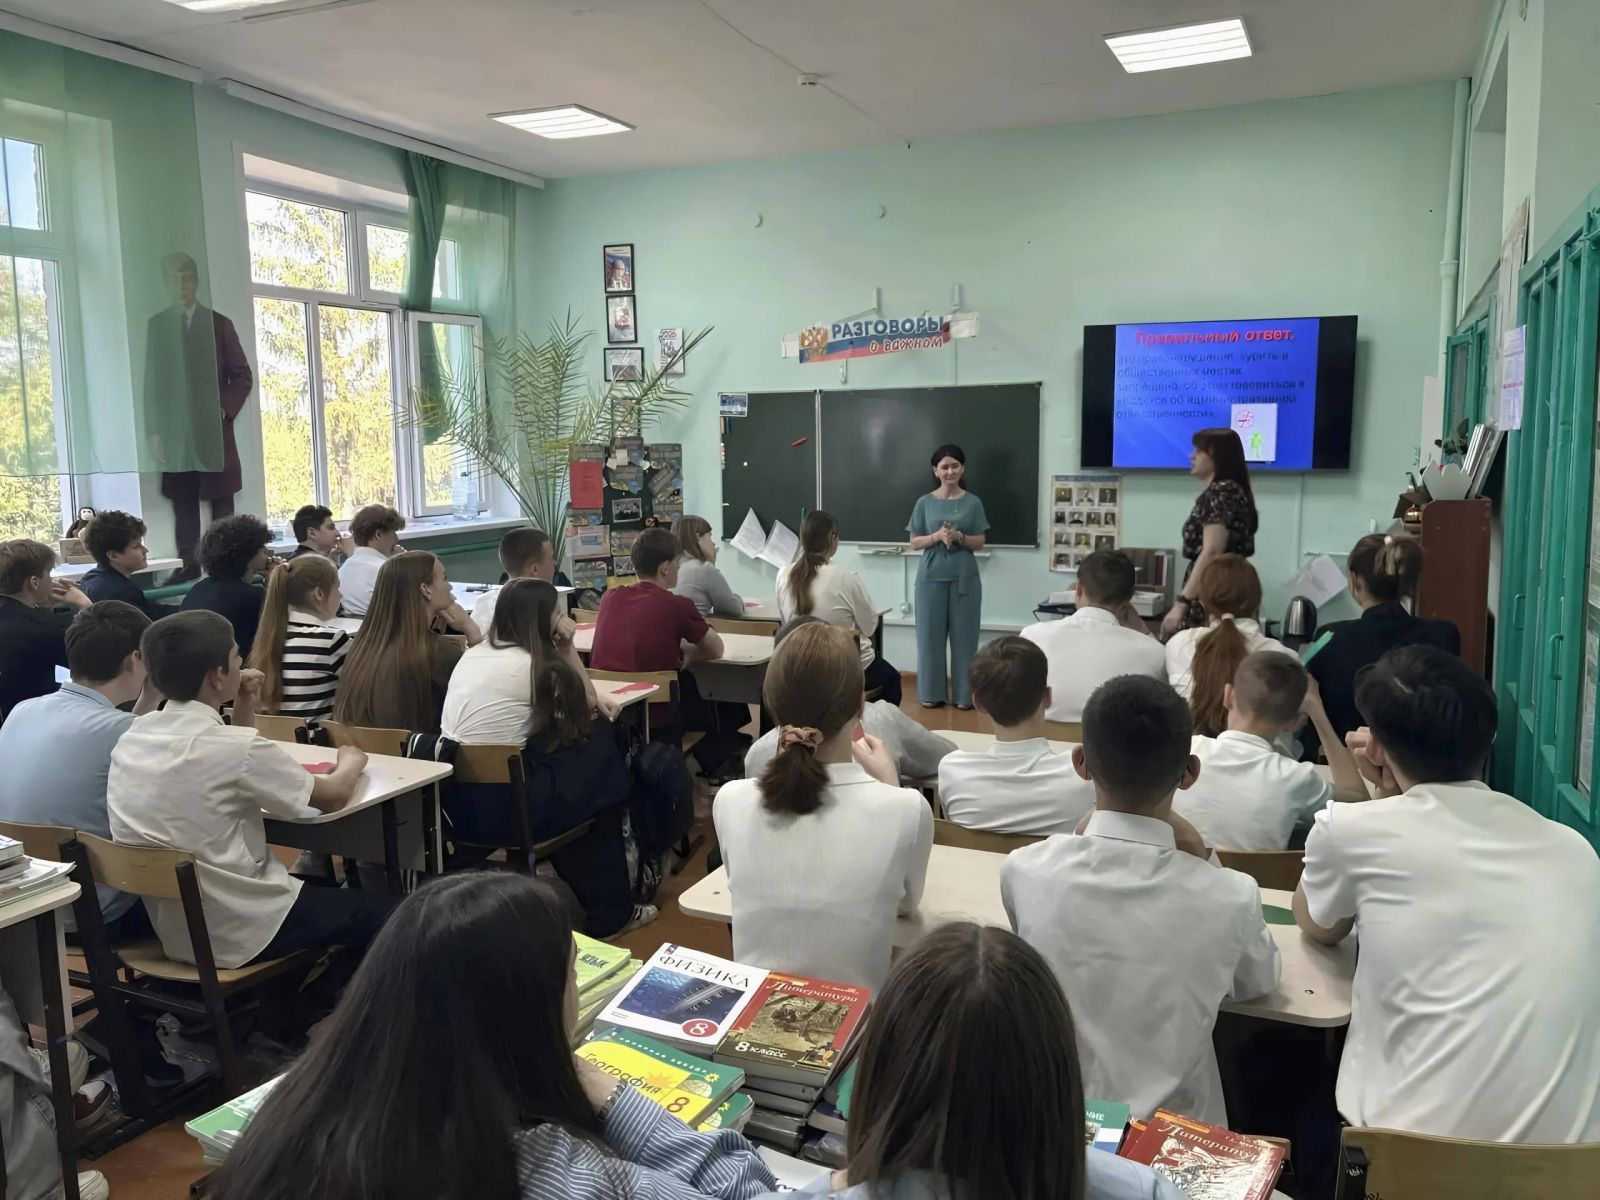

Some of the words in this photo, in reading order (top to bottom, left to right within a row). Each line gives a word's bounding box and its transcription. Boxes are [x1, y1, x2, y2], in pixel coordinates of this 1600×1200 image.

[831, 316, 944, 339] РАЗГОВОРЫ
[660, 955, 749, 988] ФИЗИКА
[690, 1022, 709, 1036] 8
[734, 1041, 750, 1052] 8
[666, 1096, 690, 1114] 8
[1157, 1124, 1262, 1163] Литератур
